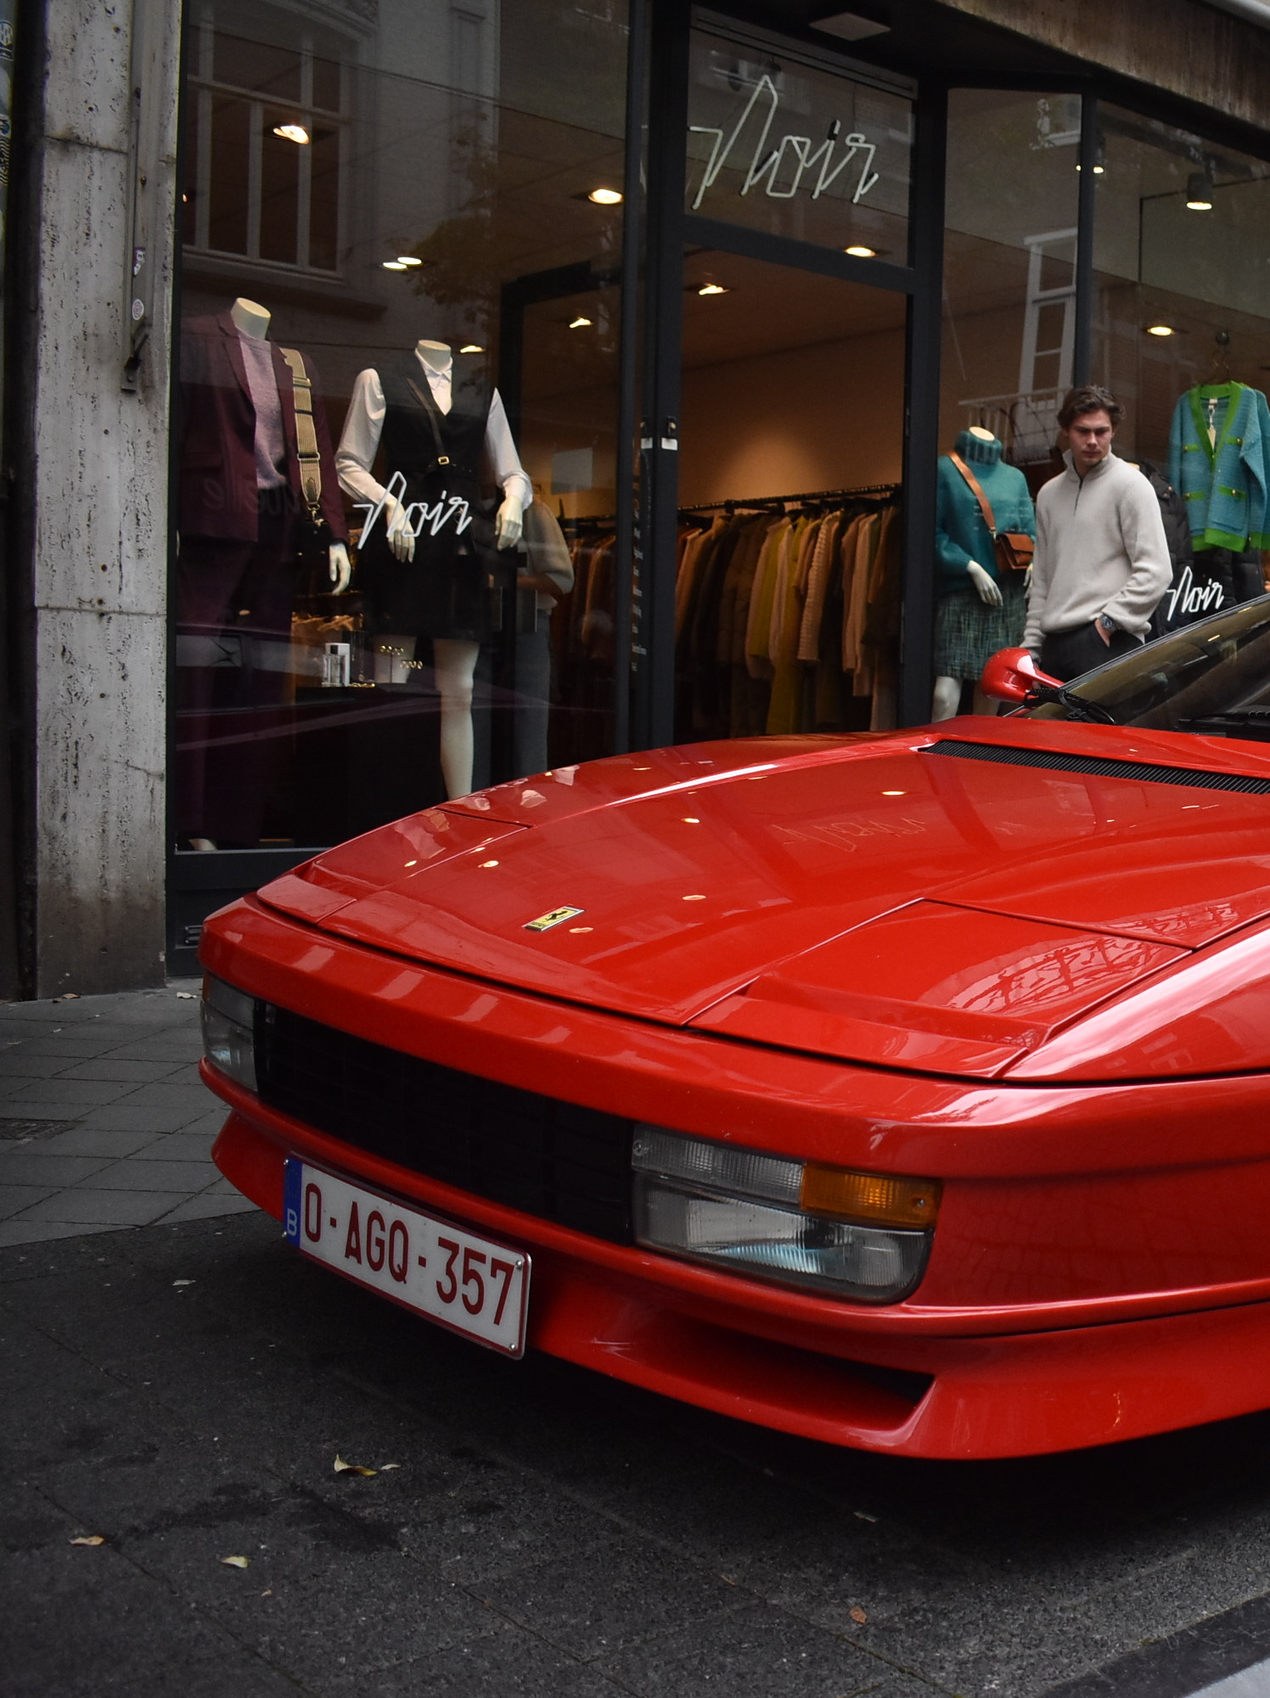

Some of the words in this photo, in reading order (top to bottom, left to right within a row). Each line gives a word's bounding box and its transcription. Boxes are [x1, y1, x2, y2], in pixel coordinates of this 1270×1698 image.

[688, 74, 879, 210] Noir
[352, 470, 473, 550] Noir
[1166, 565, 1225, 622] Noir
[286, 1207, 298, 1237] B
